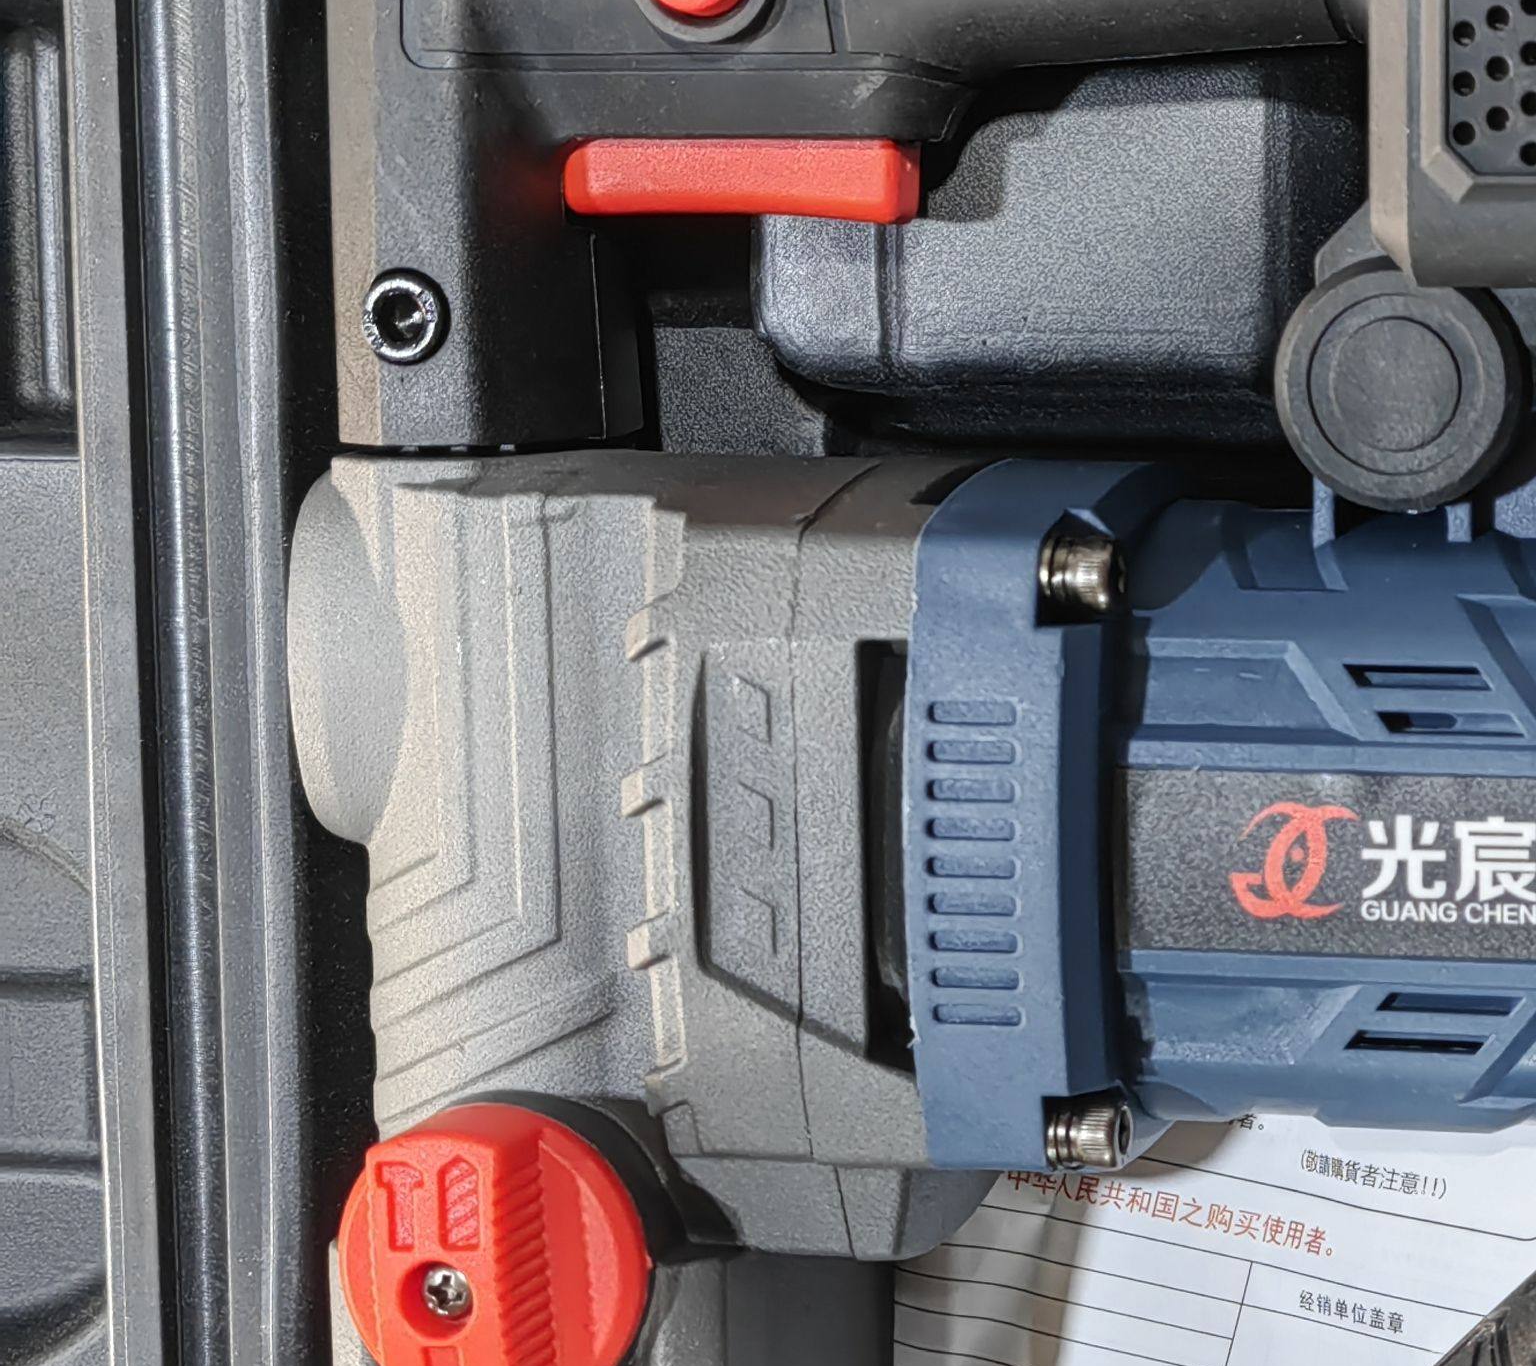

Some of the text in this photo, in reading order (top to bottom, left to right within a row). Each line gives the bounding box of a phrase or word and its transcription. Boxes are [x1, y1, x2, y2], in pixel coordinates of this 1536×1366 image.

[1361, 903, 1457, 923] GUANG
[1300, 1290, 1404, 1334] 经销单位盖章
